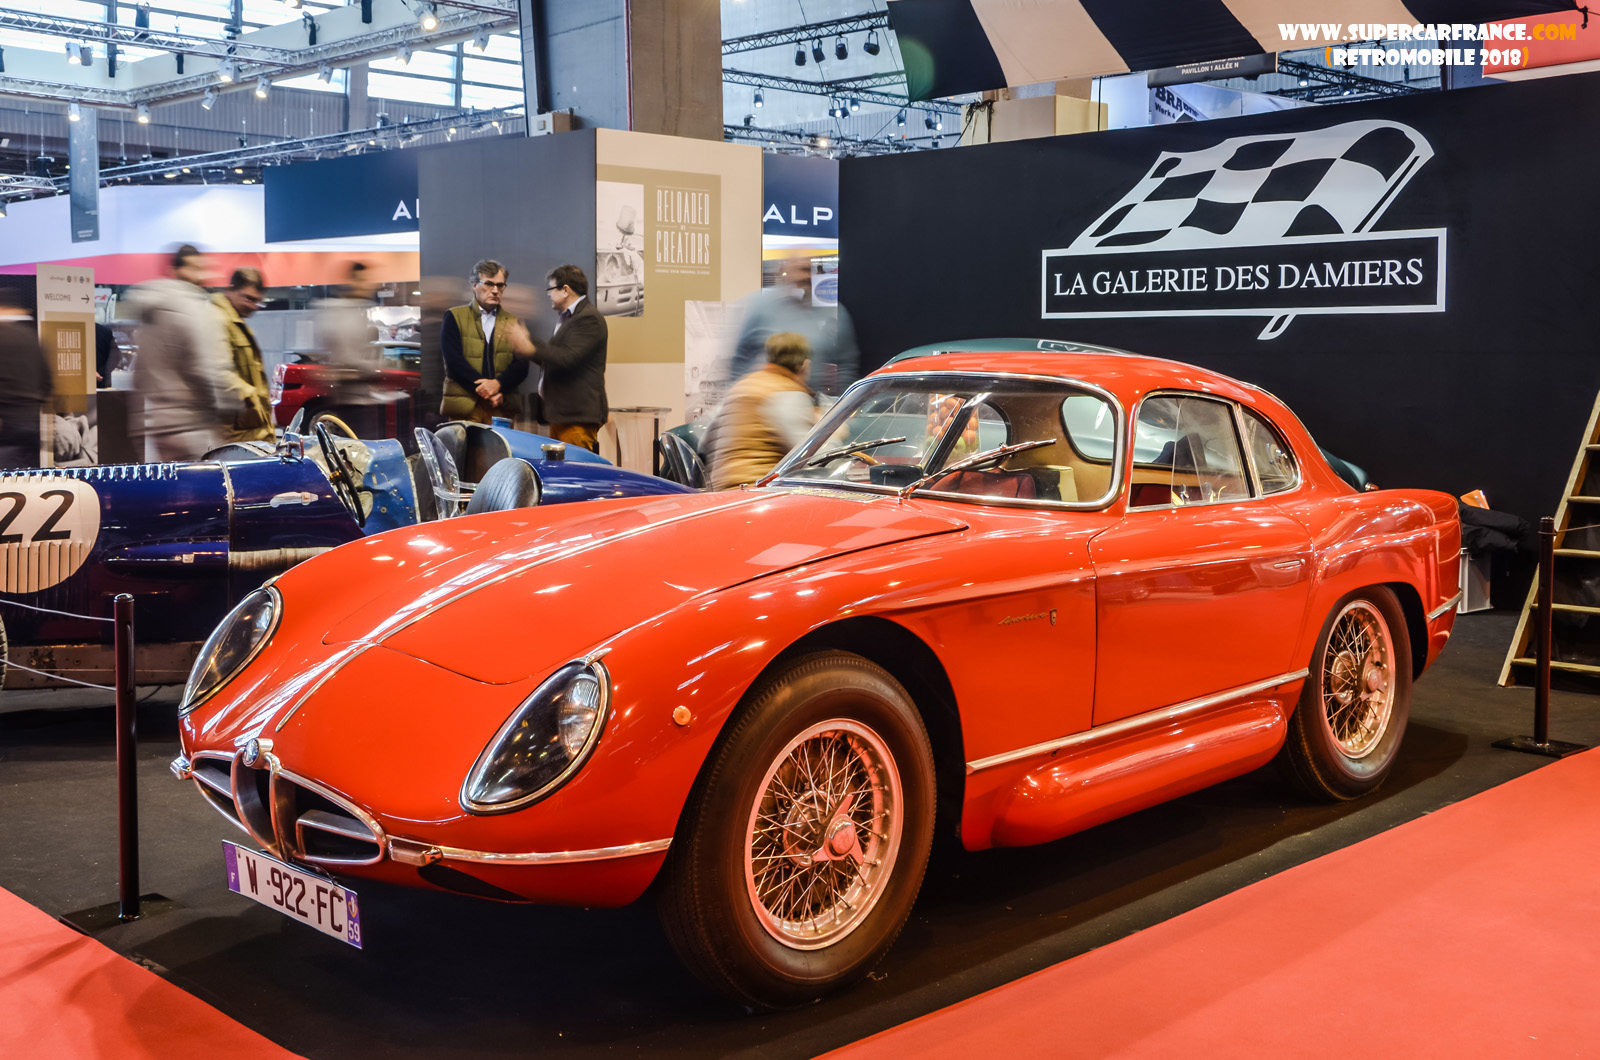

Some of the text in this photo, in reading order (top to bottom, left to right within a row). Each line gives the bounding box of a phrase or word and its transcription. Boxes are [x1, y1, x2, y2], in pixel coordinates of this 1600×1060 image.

[1181, 65, 1209, 75] PAVILLON
[656, 189, 710, 225] RELOADED
[762, 203, 834, 226] ALP
[656, 230, 710, 265] CREATORS
[1053, 257, 1424, 296] LA GALERIE DES DAMIERS
[44, 293, 72, 302] WELCOME
[0, 489, 75, 544] 22
[230, 871, 236, 884] F
[347, 919, 361, 943] 59
